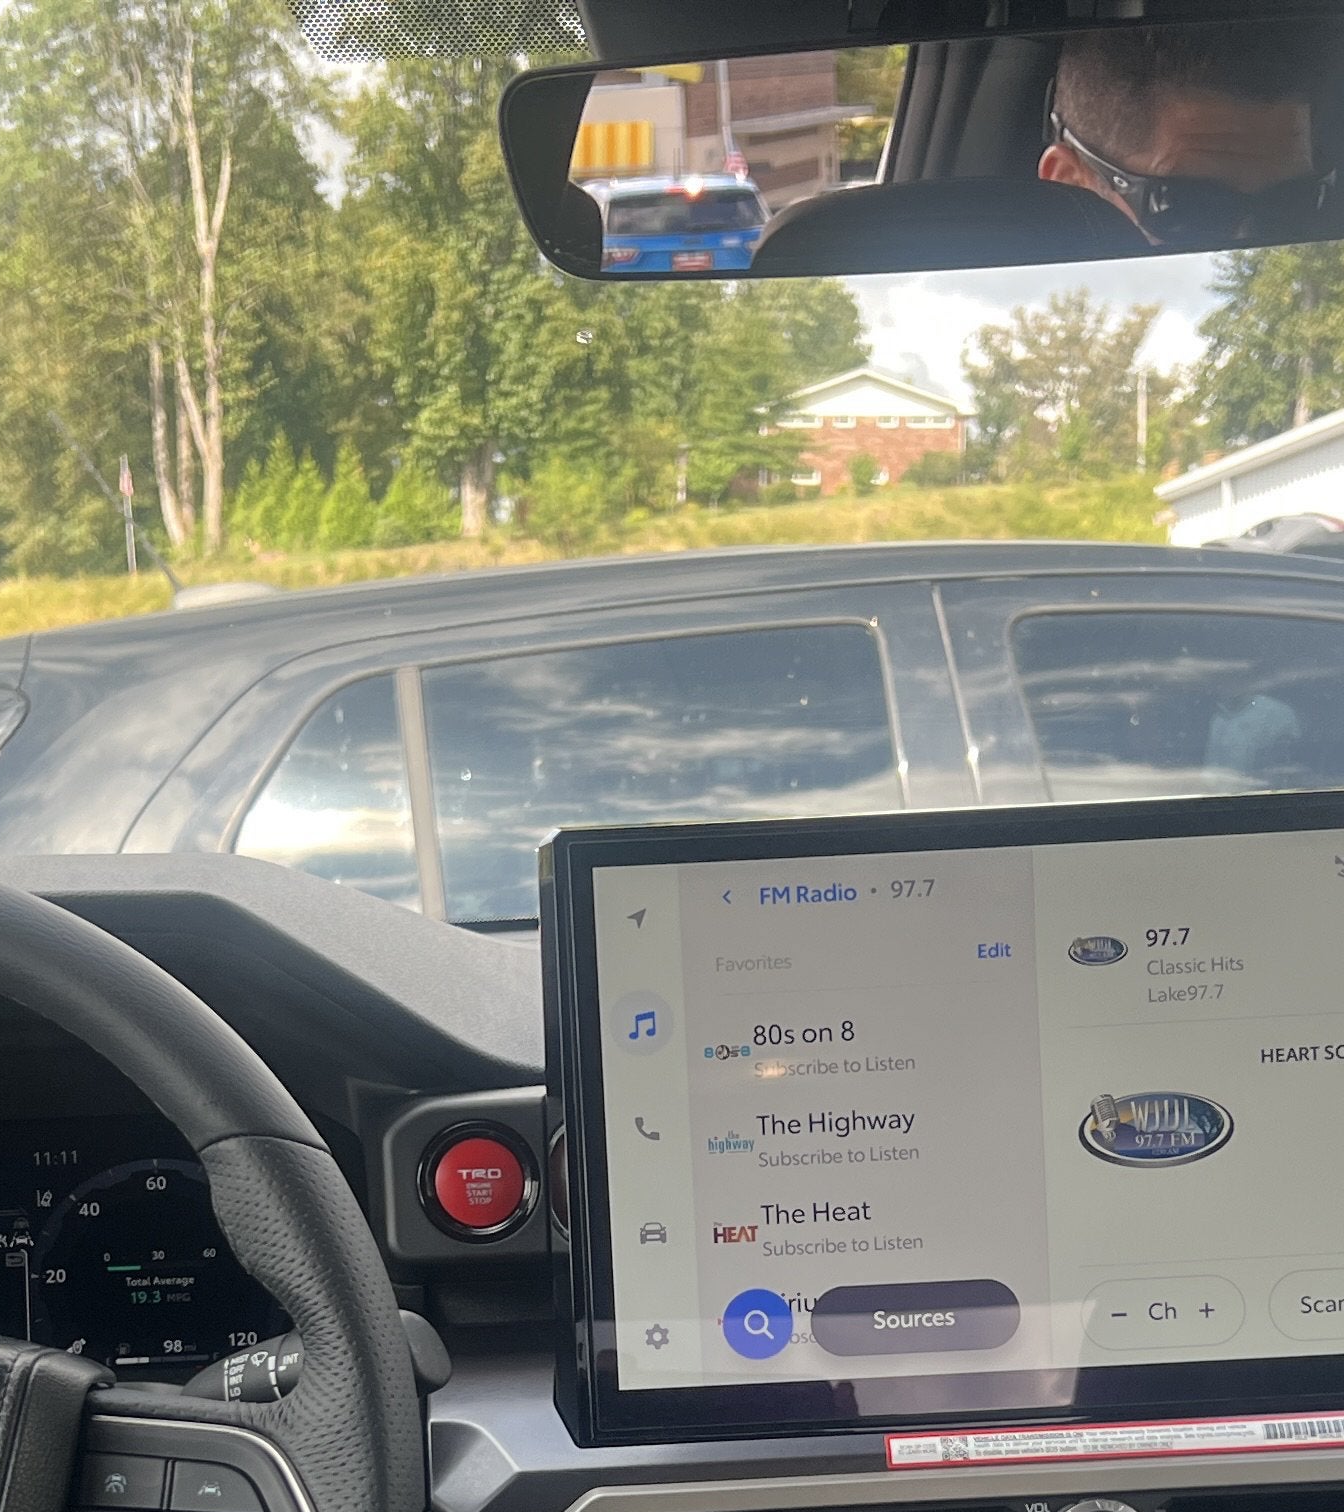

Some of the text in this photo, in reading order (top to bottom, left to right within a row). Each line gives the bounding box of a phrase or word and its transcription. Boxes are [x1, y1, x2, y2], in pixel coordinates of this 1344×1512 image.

[760, 879, 936, 905] FM Radio 97.7
[1145, 927, 1191, 947] 97.7
[977, 942, 1012, 959] Edit
[715, 955, 793, 972] Favorites
[1147, 956, 1244, 976] Classic Hits
[1147, 984, 1224, 1003] Lake97.7
[753, 1020, 855, 1046] 80s on 8
[1261, 1045, 1320, 1064] HEART
[754, 1055, 916, 1079] Subscribe to Listen
[757, 1109, 916, 1138] The Highway
[708, 1136, 755, 1153] highway
[1135, 1132, 1195, 1148] 97.7 FM
[33, 1150, 78, 1167] 11:11
[758, 1146, 920, 1168] Subscribe to Listen
[457, 1168, 502, 1180] TRD
[146, 1175, 166, 1191] 60
[466, 1189, 493, 1197] START
[469, 1197, 492, 1205] STOP
[79, 1202, 100, 1217] 40
[760, 1201, 872, 1225] The Heat
[712, 1225, 759, 1244] HEAT
[203, 1248, 216, 1258] 60
[762, 1235, 924, 1257] Subscribe to Listen
[103, 1252, 111, 1262] 0
[152, 1250, 165, 1260] 30
[45, 1268, 66, 1284] 20
[126, 1276, 195, 1287] Total Average
[131, 1290, 162, 1304] 19.3
[1148, 1302, 1177, 1321] Ch
[873, 1310, 956, 1331] Sources
[163, 1340, 183, 1353] 98
[228, 1331, 258, 1347] 120
[283, 1353, 299, 1365] INT
[230, 1387, 241, 1397] LO
